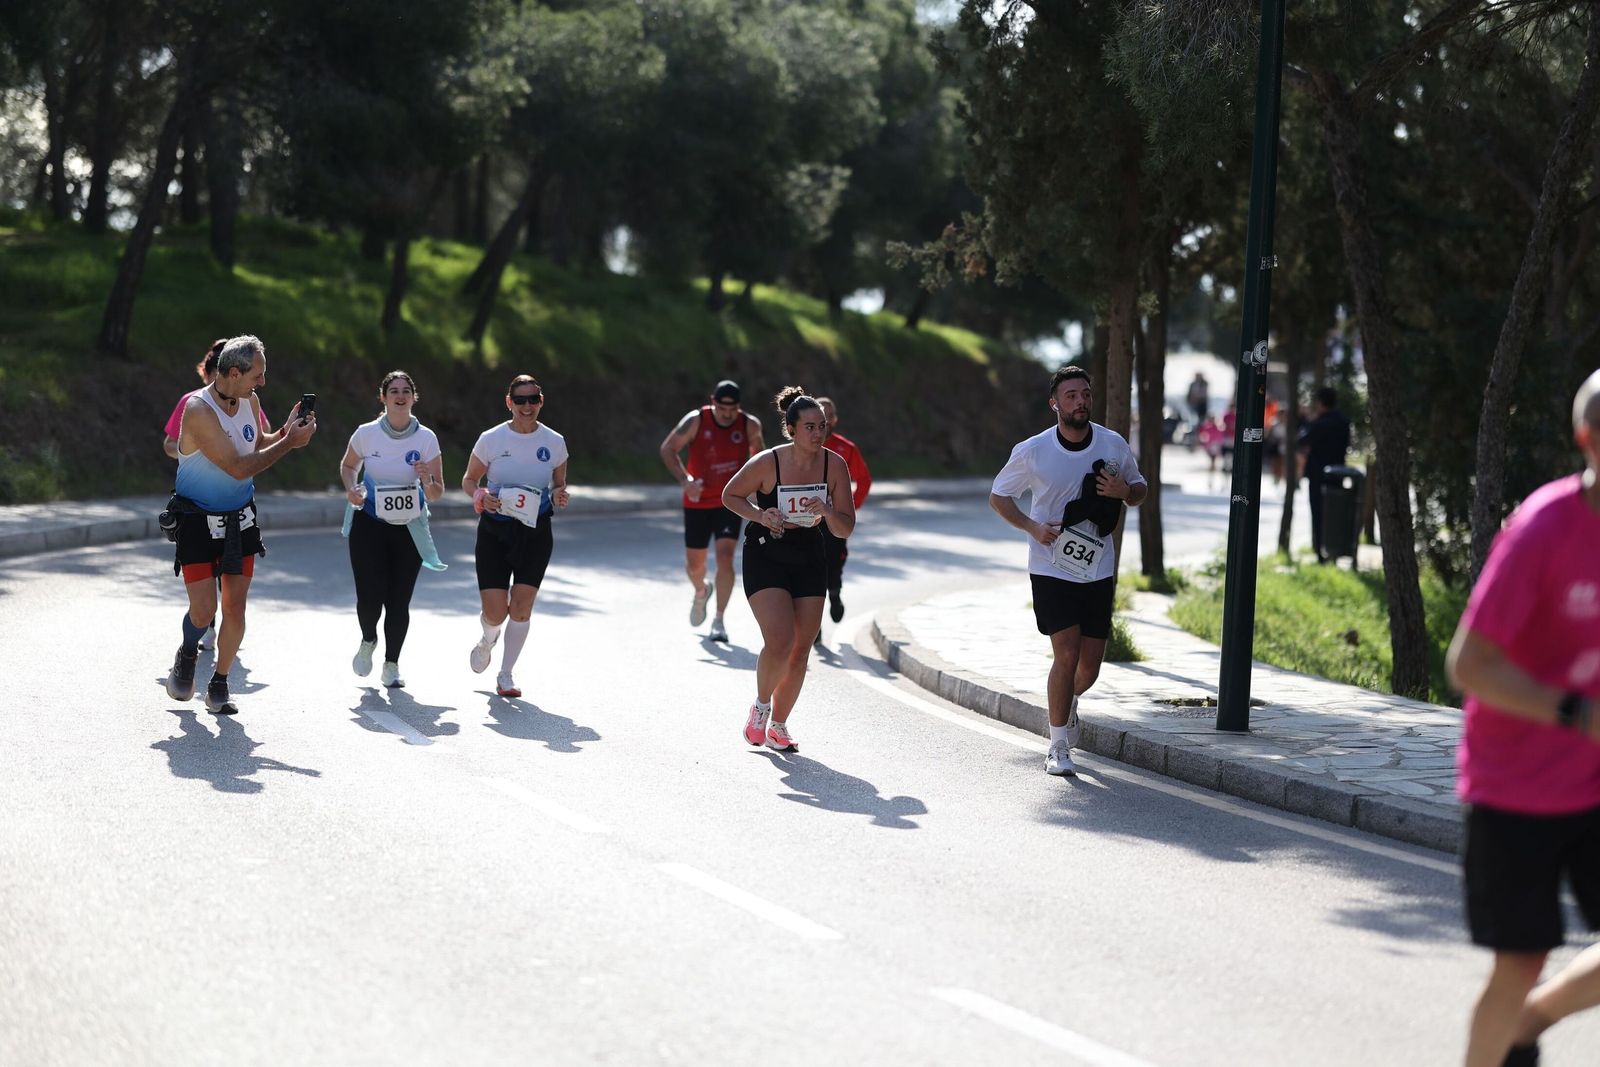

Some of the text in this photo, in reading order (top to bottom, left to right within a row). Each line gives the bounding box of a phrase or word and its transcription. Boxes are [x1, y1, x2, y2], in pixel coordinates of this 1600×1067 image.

[384, 495, 414, 511] 808
[515, 494, 526, 508] 3
[1062, 540, 1096, 566] 634
